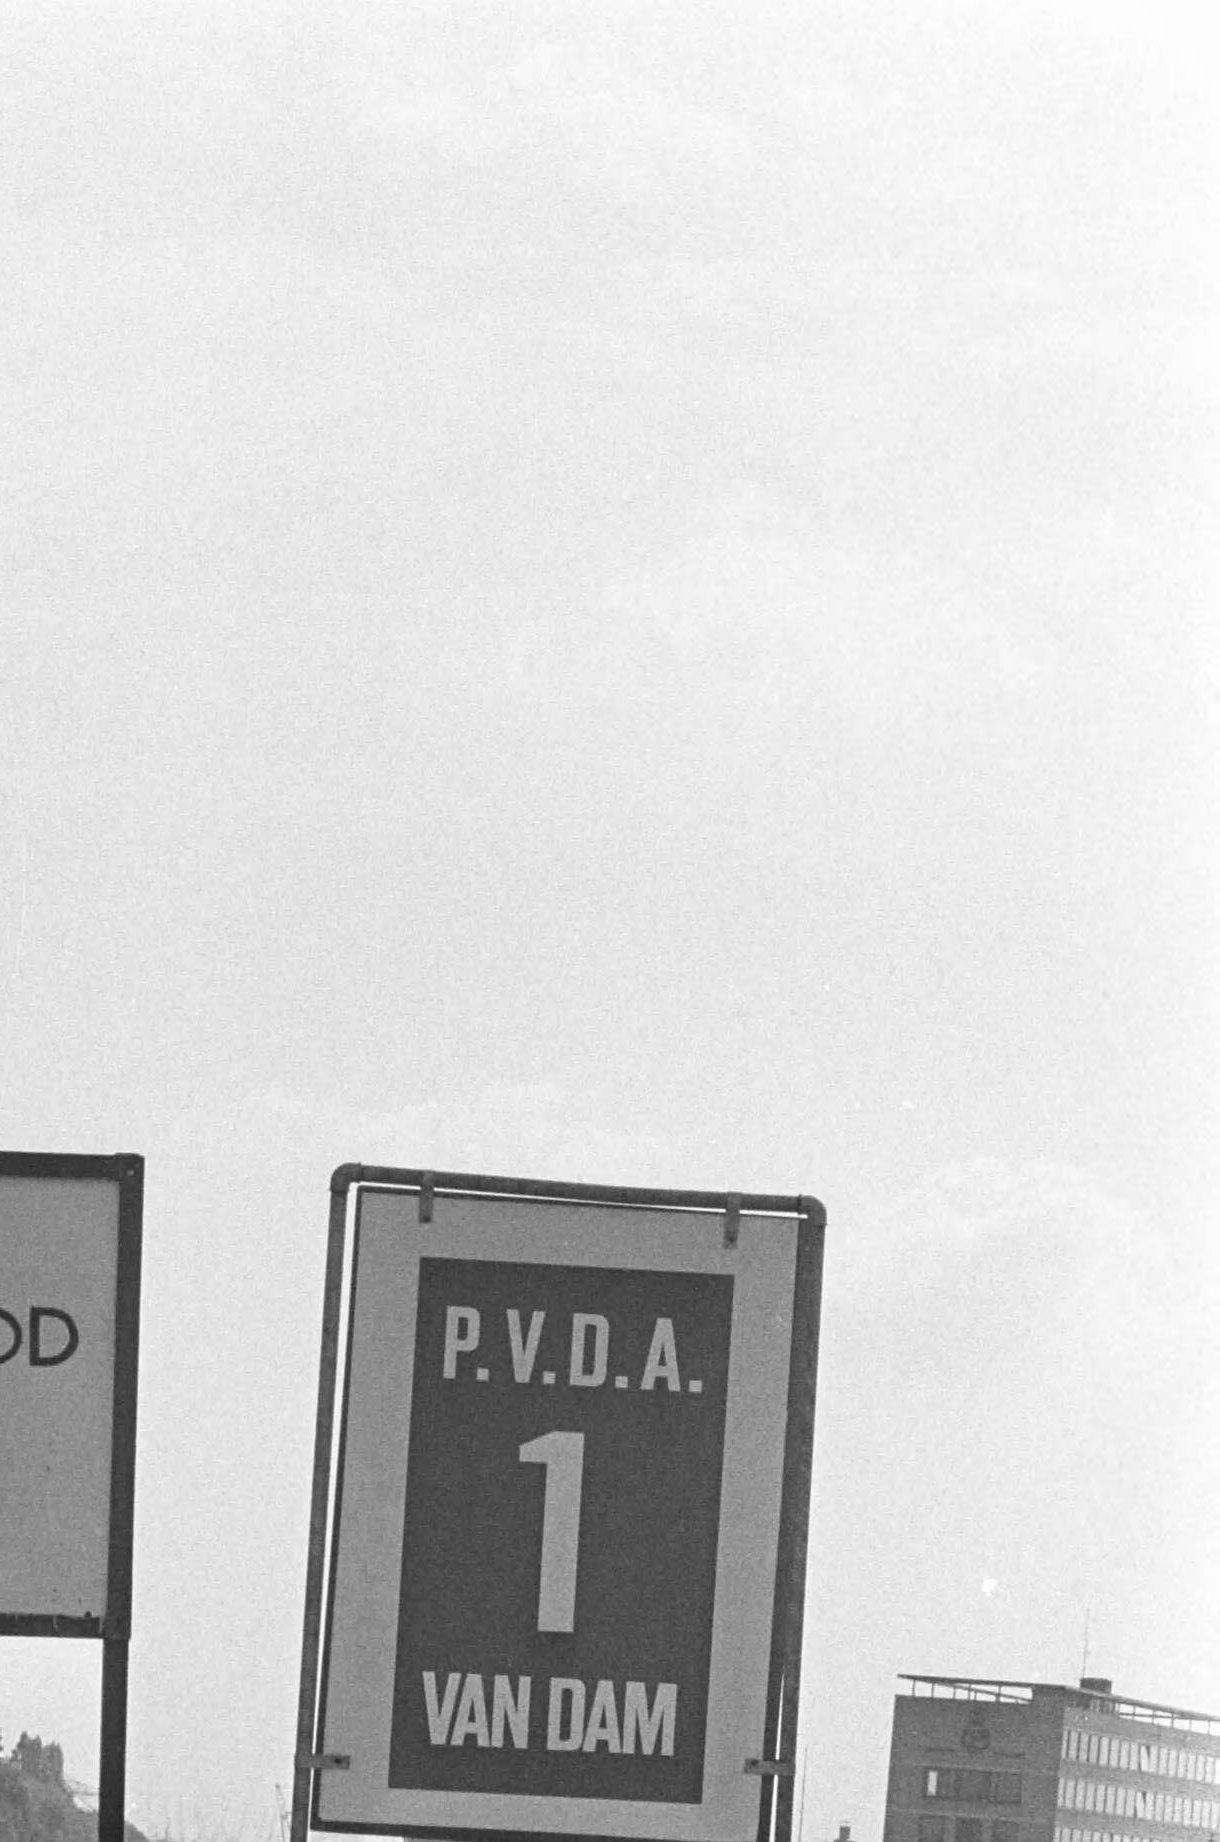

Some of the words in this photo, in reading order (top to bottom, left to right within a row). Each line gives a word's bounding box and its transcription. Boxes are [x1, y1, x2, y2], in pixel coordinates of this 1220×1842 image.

[442, 1305, 703, 1394] P.V.D.A.
[518, 1430, 585, 1633] 1
[422, 1670, 532, 1750] VAN
[546, 1677, 678, 1757] DAM
